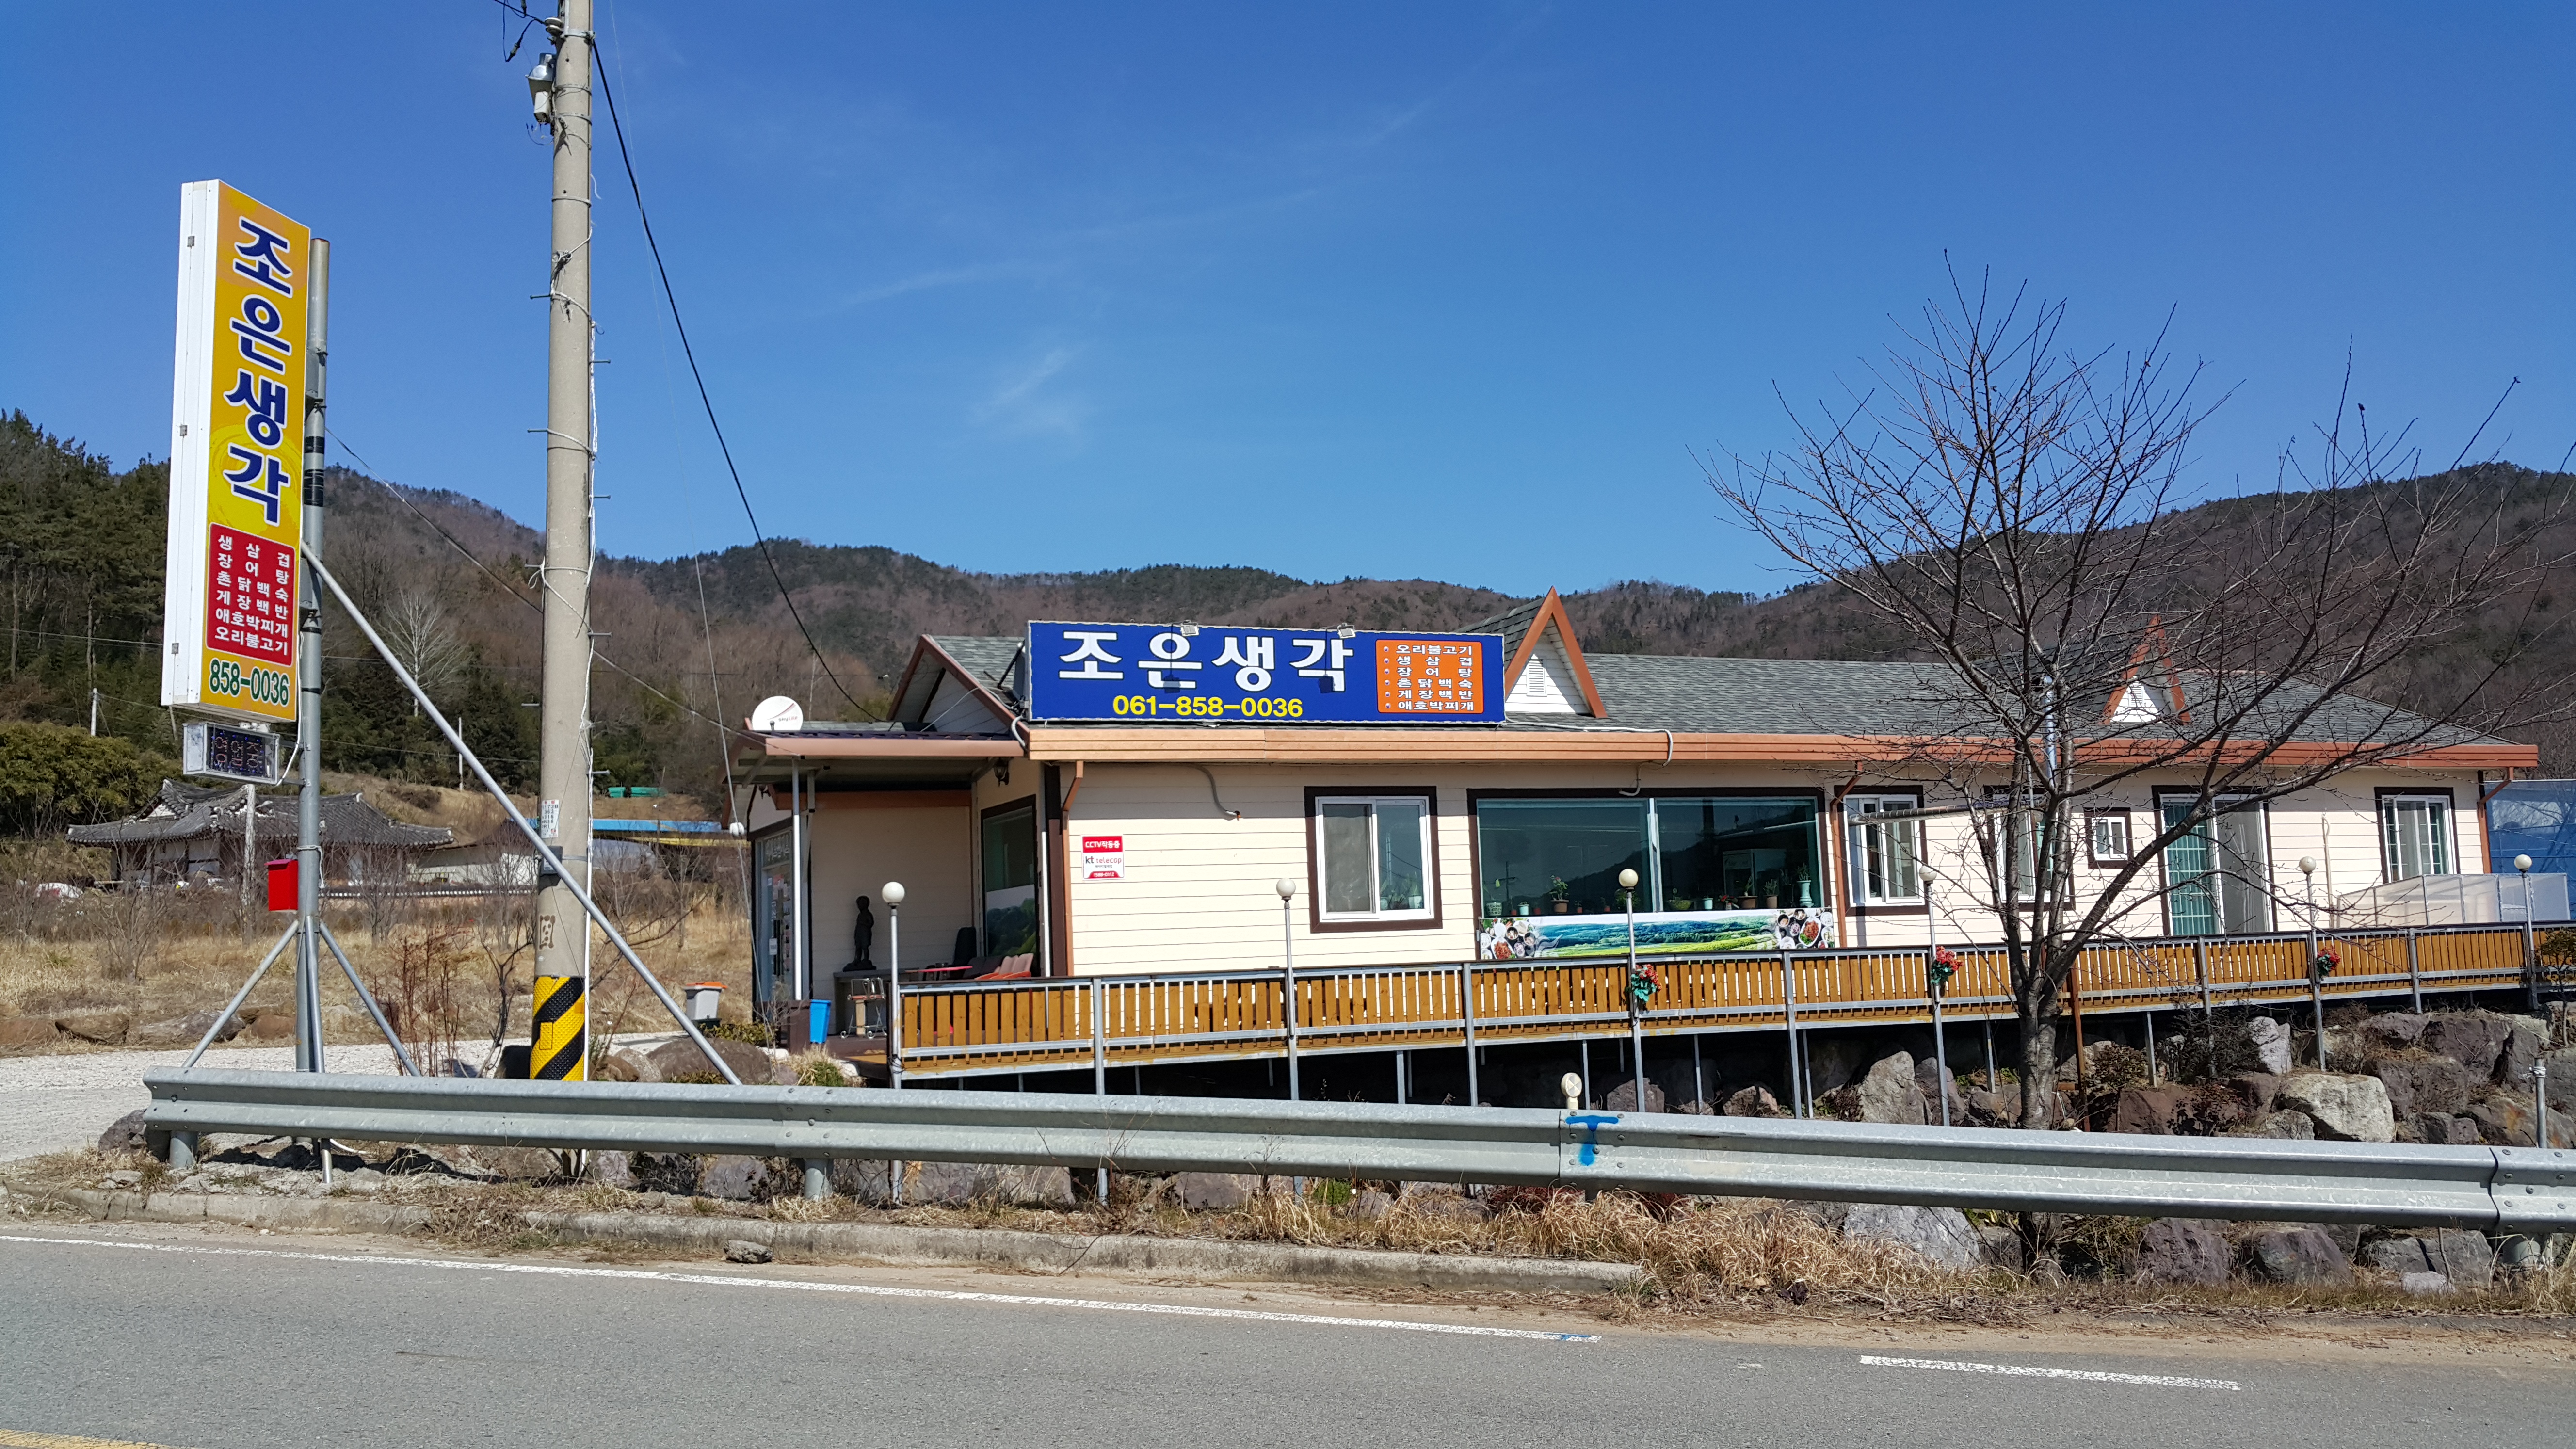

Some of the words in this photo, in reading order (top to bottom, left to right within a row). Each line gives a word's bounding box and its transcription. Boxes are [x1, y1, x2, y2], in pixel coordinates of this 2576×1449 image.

[223, 216, 292, 526] 조은생각
[215, 607, 289, 638] 애호박찌개
[215, 626, 288, 656] 오리불고기
[1396, 644, 1473, 655] 오리불고기
[1059, 631, 1353, 692] 조은생각
[209, 657, 290, 707] 858-0036
[1113, 695, 1303, 717] 061-858-0036
[1398, 701, 1474, 711] 애호박찌개
